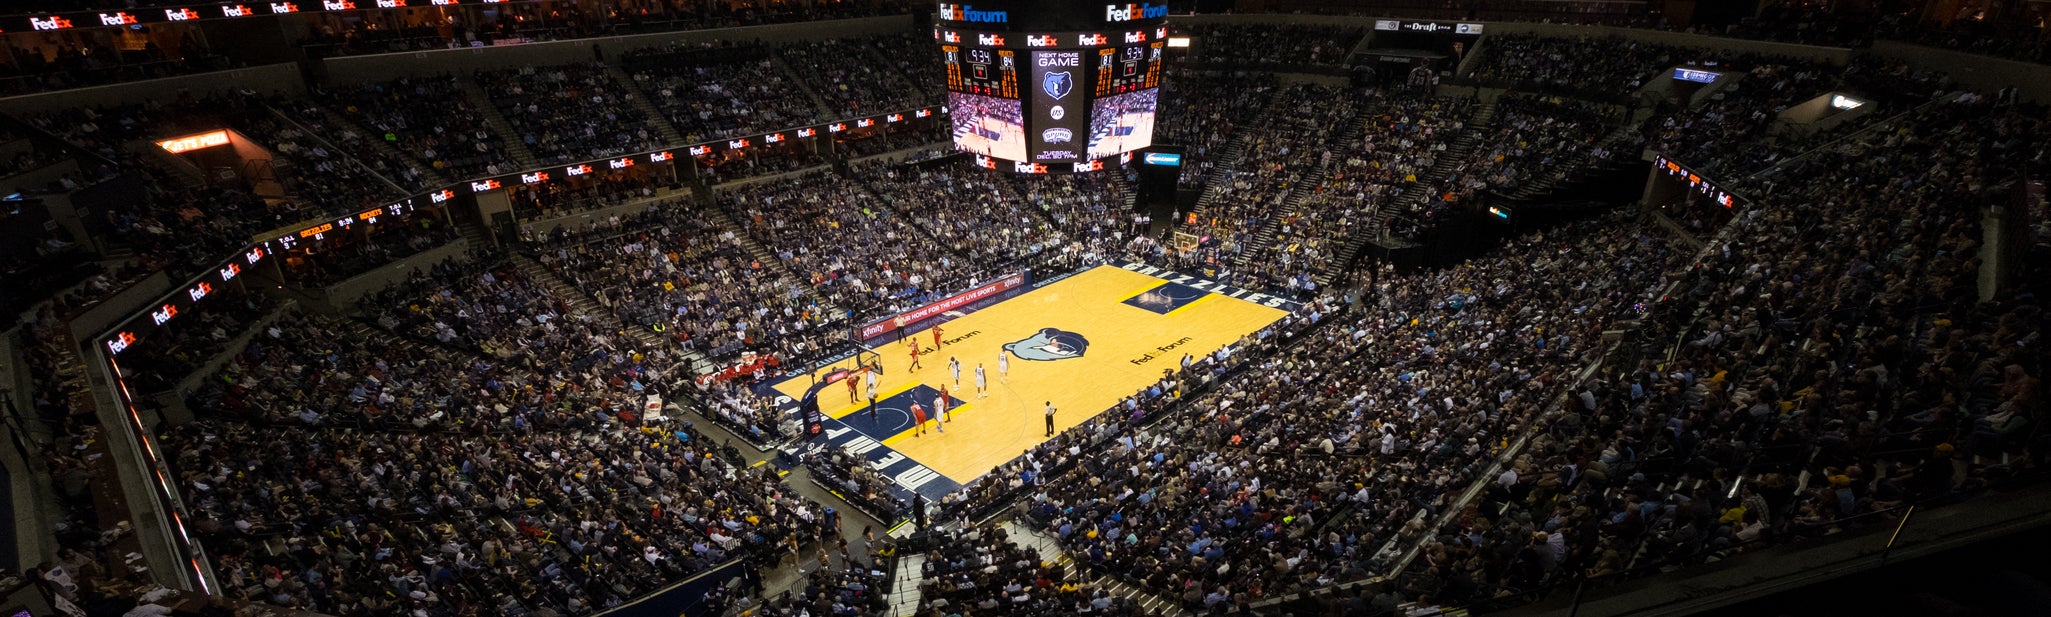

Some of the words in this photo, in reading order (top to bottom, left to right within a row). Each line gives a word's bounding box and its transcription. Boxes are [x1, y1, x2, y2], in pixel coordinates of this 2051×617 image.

[29, 16, 73, 30] FedEx
[99, 12, 138, 25] FedEx
[164, 8, 199, 21] FedEx
[221, 5, 253, 17] FedEx
[270, 2, 299, 14] FedEx
[323, 0, 356, 11] FedEx
[940, 4, 1008, 22] FedExForum
[1412, 22, 1437, 32] Draft
[979, 33, 1005, 46] FedEx
[1027, 34, 1057, 47] FedEx
[1079, 33, 1107, 46] FedEx
[1125, 30, 1146, 44] FedEx
[1038, 58, 1079, 67] GAME
[430, 189, 455, 204] FedEx
[471, 179, 501, 192] FedEx
[521, 172, 549, 184] FedEx
[566, 164, 593, 176] FedEx
[610, 157, 635, 169] FedEx
[650, 151, 674, 163] FedEx
[689, 145, 712, 156] FedEx
[729, 139, 750, 150] FedEx
[765, 133, 785, 144] FedEx
[797, 128, 817, 138] FedEx
[829, 122, 847, 133] FedEx
[857, 117, 875, 128] FedEx
[887, 114, 903, 123] FedEx
[915, 109, 932, 118] FedEx
[976, 154, 996, 169] FedEx
[1014, 161, 1048, 174] FedEx
[1073, 159, 1104, 172] FedEx
[1718, 191, 1733, 209] FedEx
[300, 223, 332, 238] GRIZZLIES
[1122, 260, 1287, 308] GRIZZLIES
[107, 331, 137, 355] FedEx
[151, 303, 178, 326] FedEx
[189, 282, 213, 302] FedEx
[220, 262, 241, 281] FedEx
[862, 324, 884, 337] xfinity
[911, 309, 928, 320] HOME
[928, 304, 940, 315] FOR
[940, 301, 951, 312] THE
[950, 296, 966, 309] MOST
[966, 292, 977, 303] LIVE
[977, 286, 996, 298] SPORTS
[1003, 275, 1021, 288] xfinity
